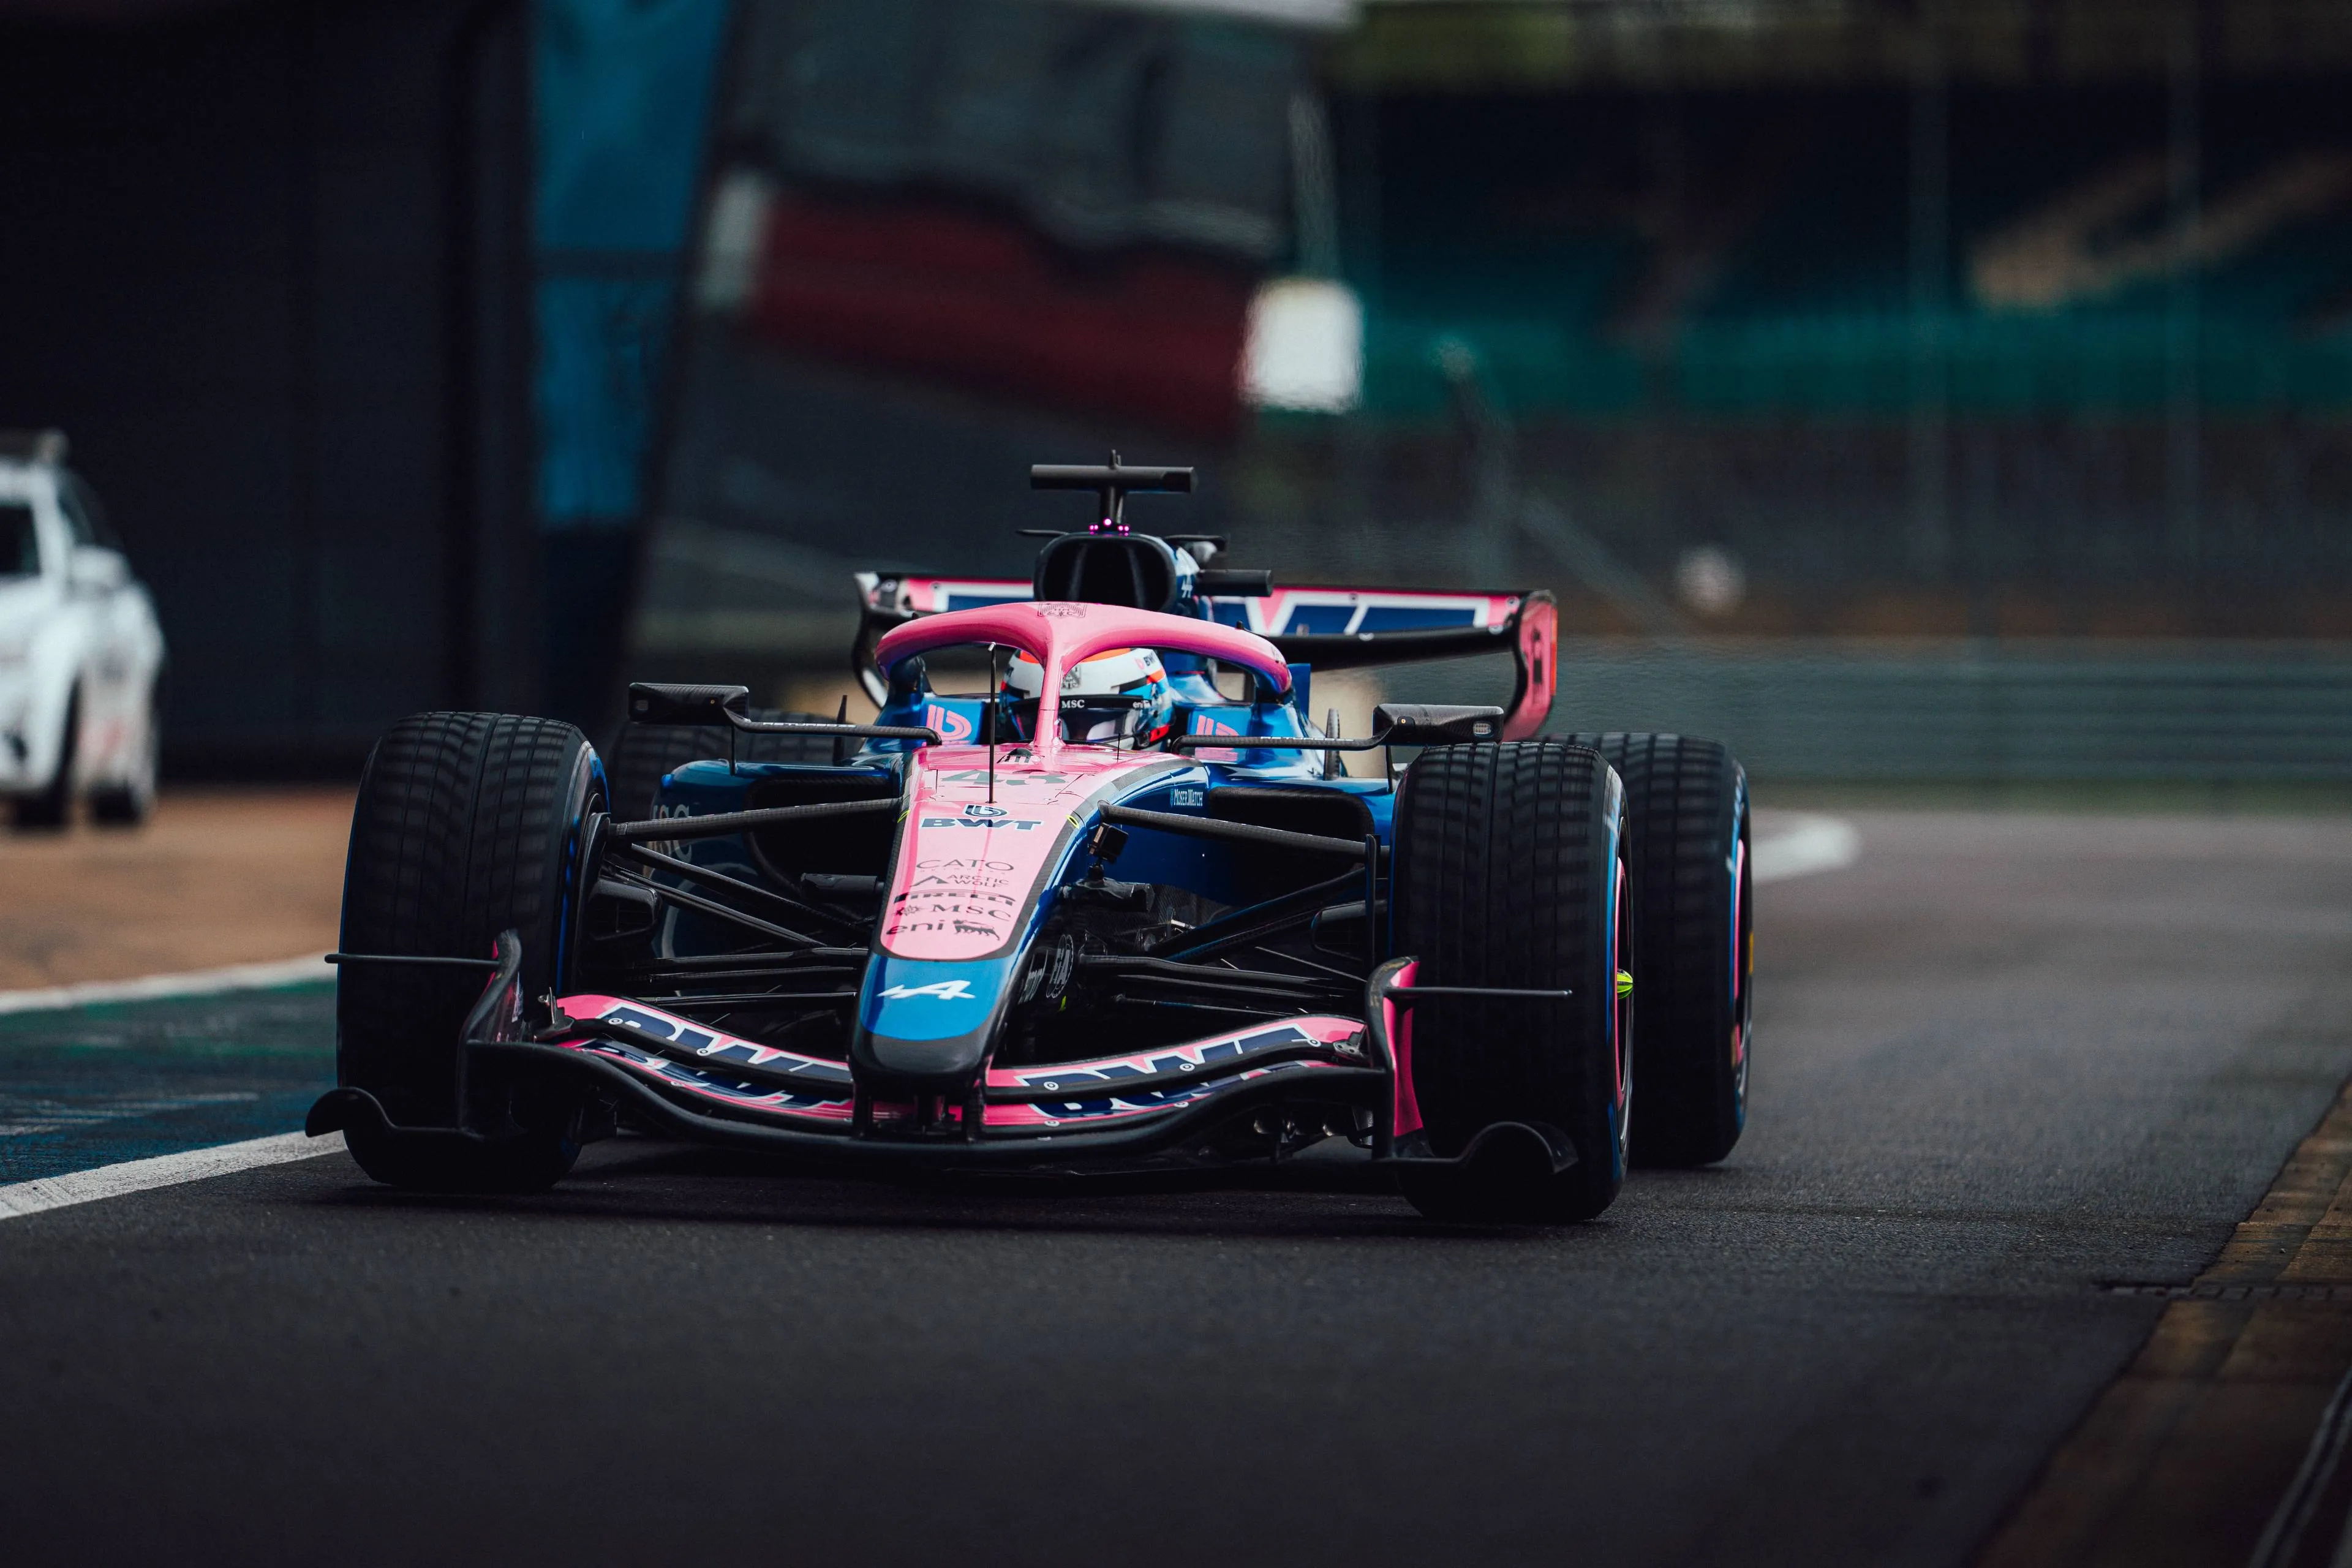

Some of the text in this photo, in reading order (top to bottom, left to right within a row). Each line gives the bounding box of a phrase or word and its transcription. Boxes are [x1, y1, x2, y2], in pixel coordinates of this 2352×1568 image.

[1061, 699, 1085, 709] MSC
[921, 817, 1042, 831] BWT
[916, 859, 1014, 871] CATO
[947, 875, 1009, 885] ARCTIC
[894, 889, 1016, 906] PIRELLI
[930, 904, 1011, 921] MSC
[886, 919, 946, 935] eni
